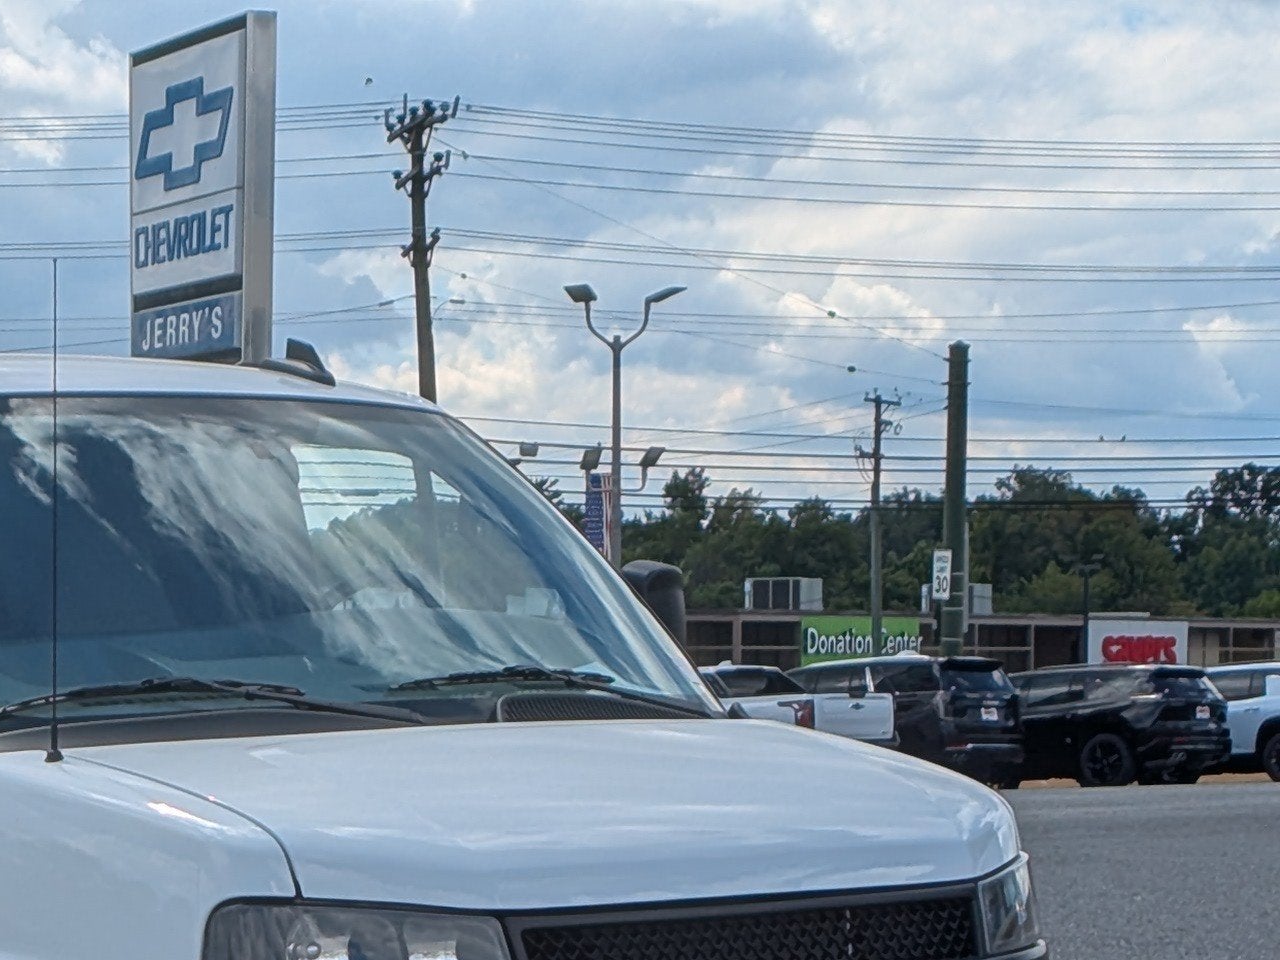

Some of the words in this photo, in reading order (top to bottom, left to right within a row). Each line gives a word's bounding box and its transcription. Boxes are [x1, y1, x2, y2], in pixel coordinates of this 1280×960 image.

[134, 204, 234, 269] CHEVROLET
[142, 306, 222, 351] JERRY'S
[934, 574, 948, 593] 30
[806, 626, 873, 654] Donation
